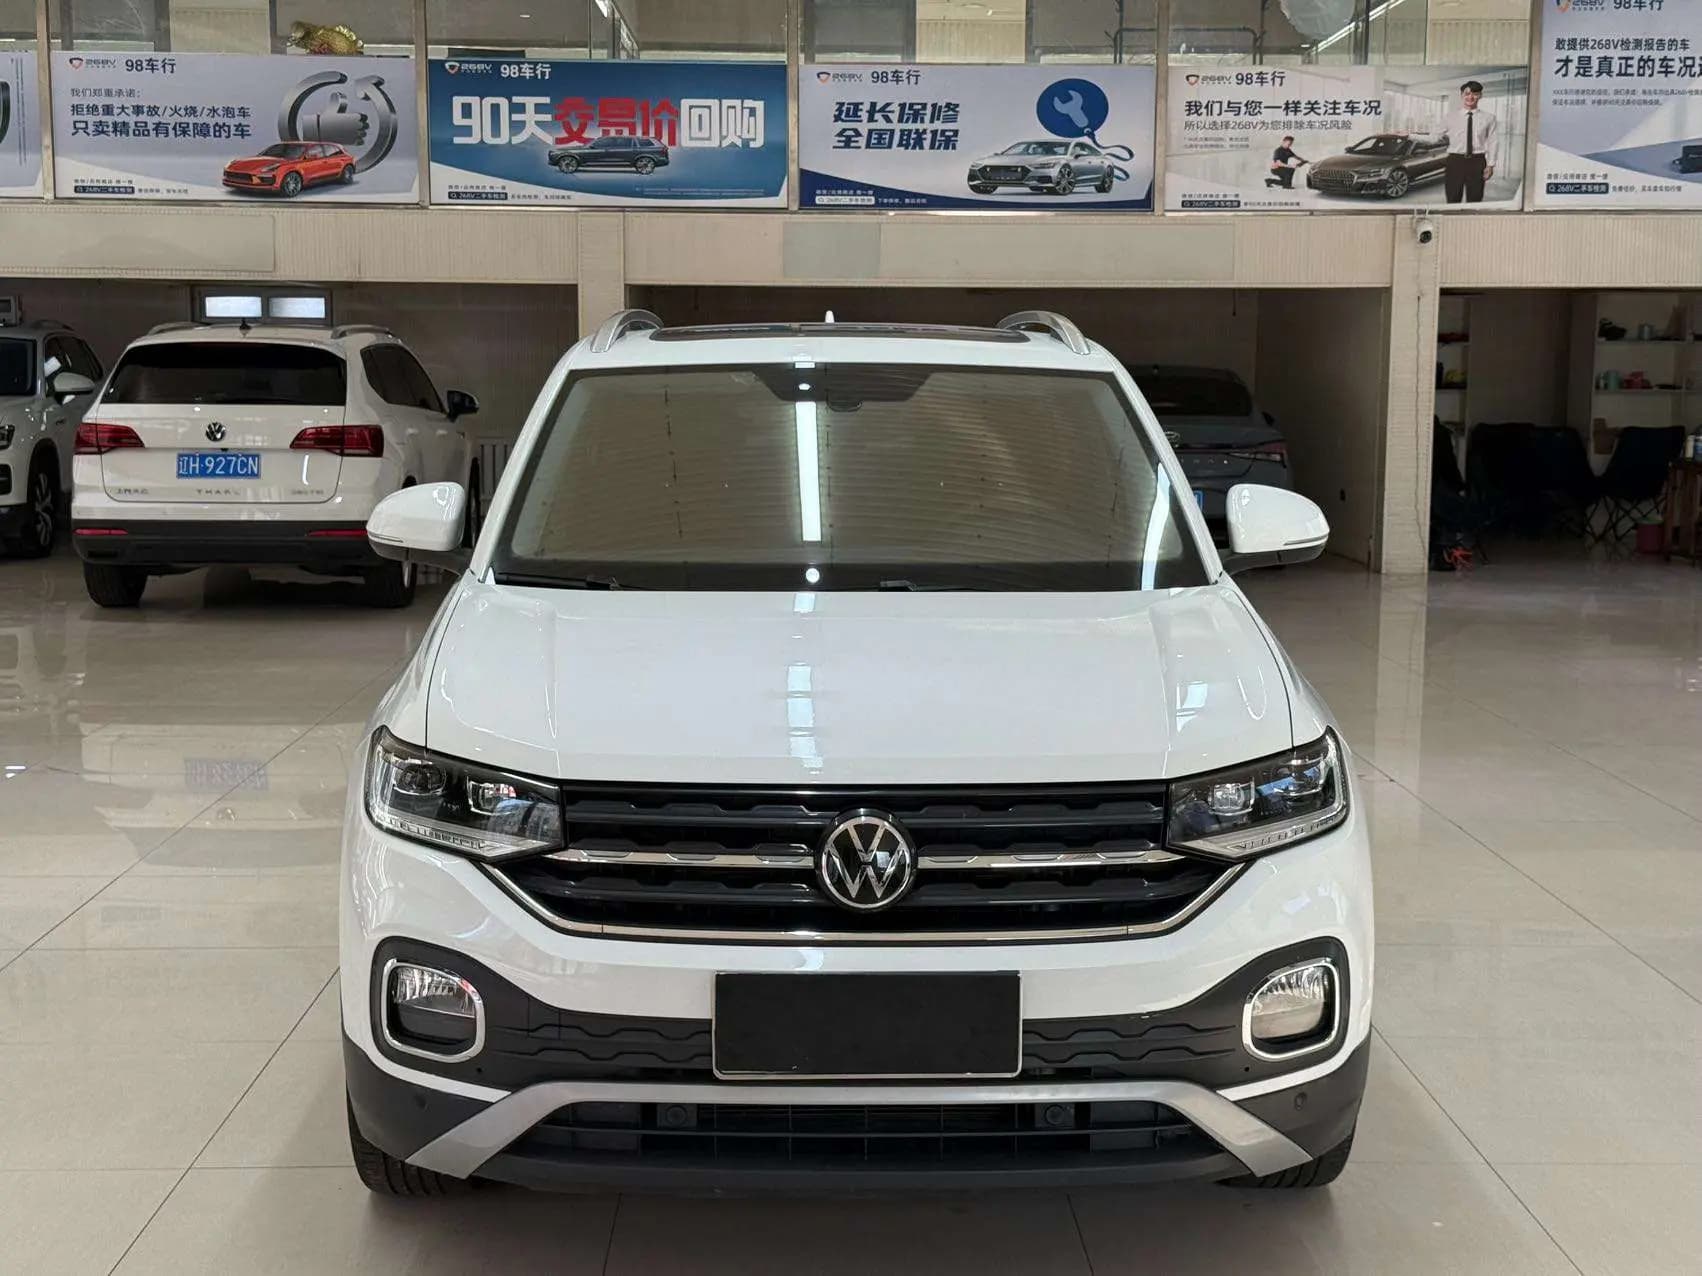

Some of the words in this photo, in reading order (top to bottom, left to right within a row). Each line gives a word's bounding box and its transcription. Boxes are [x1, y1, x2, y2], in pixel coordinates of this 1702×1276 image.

[1555, 37, 1691, 52] 敢提供268V检测报告的车
[125, 57, 177, 74] 98车行
[500, 63, 552, 80] 98车行
[871, 69, 921, 85] 98车行
[1235, 71, 1286, 87] 98车行
[70, 103, 251, 119] 拒绝重大事故/火烧/水泡车
[833, 101, 960, 124] 延长保修
[1184, 99, 1382, 117] 我们与您一样关注车况
[71, 120, 252, 139] 只卖精品有保障的车
[1184, 119, 1353, 131] 所以选择268V为您排除车况风险
[832, 127, 960, 150] 全国联保
